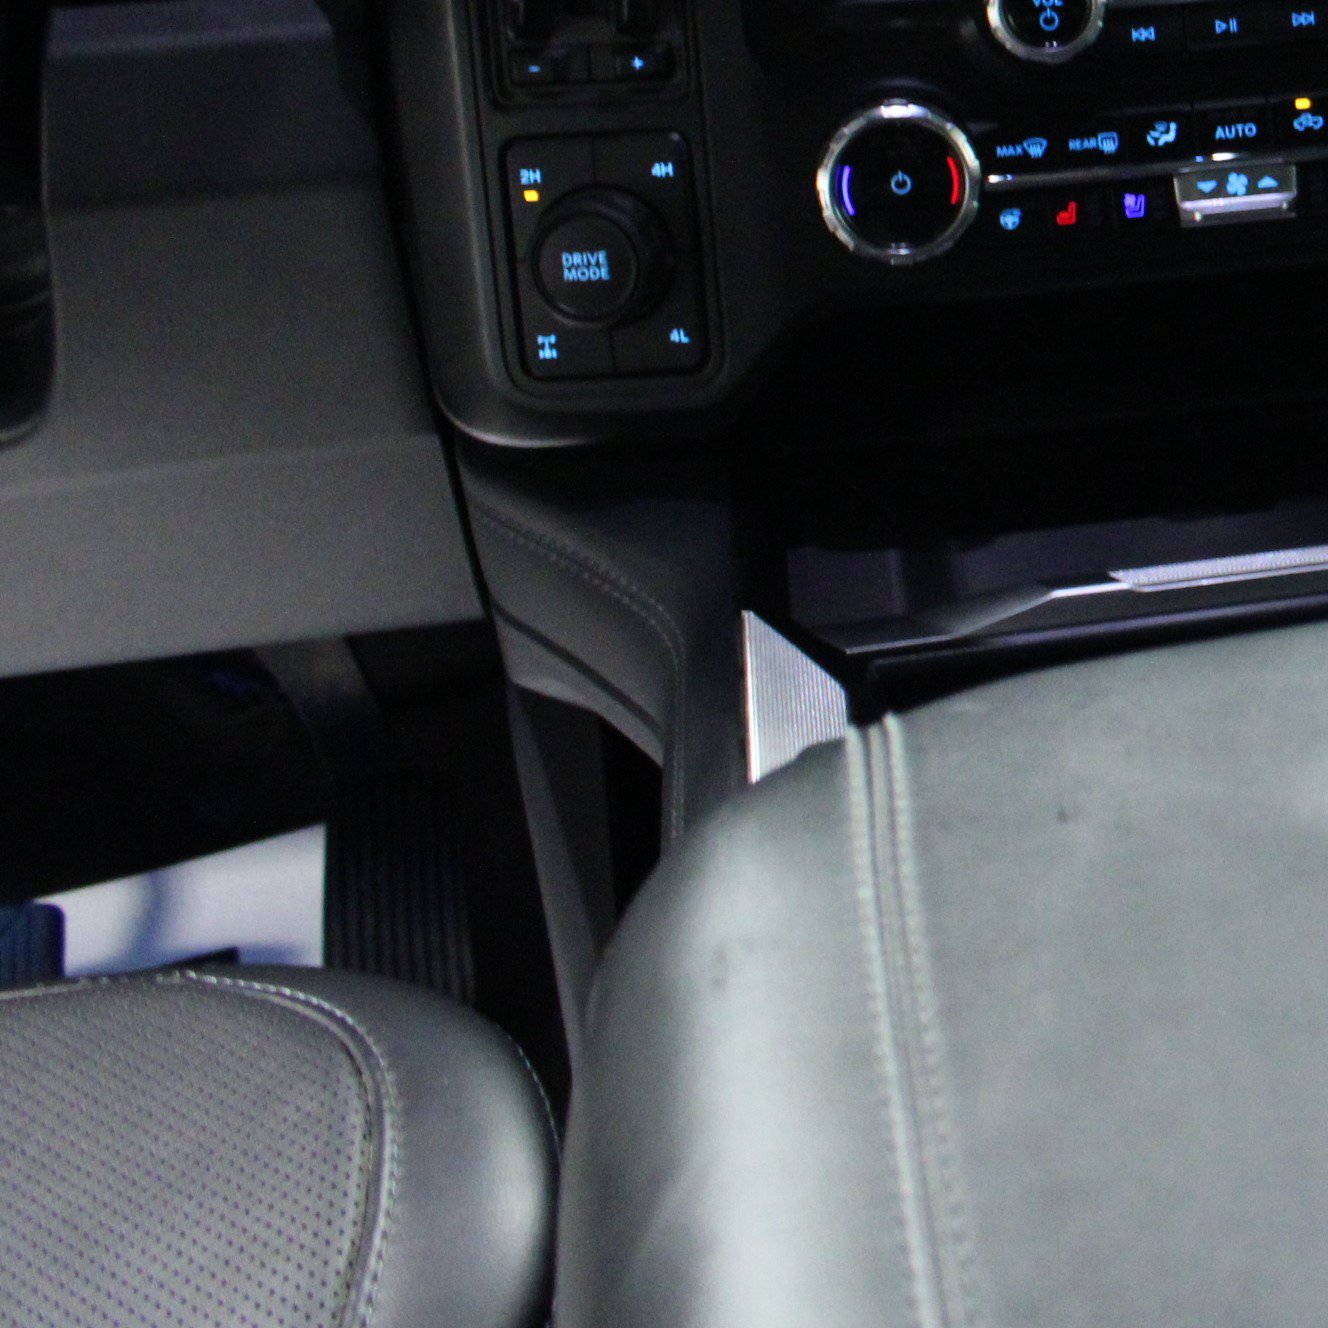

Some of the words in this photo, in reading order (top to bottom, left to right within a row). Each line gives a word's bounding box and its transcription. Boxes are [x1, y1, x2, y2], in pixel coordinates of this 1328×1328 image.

[1215, 123, 1257, 140] AUTO
[996, 144, 1023, 157] MAX
[1069, 137, 1098, 151] REAR
[520, 168, 542, 185] 2H
[651, 161, 674, 177] 4H
[561, 250, 607, 267] DRIVE
[564, 265, 611, 282] MODE
[669, 328, 690, 343] 4L
